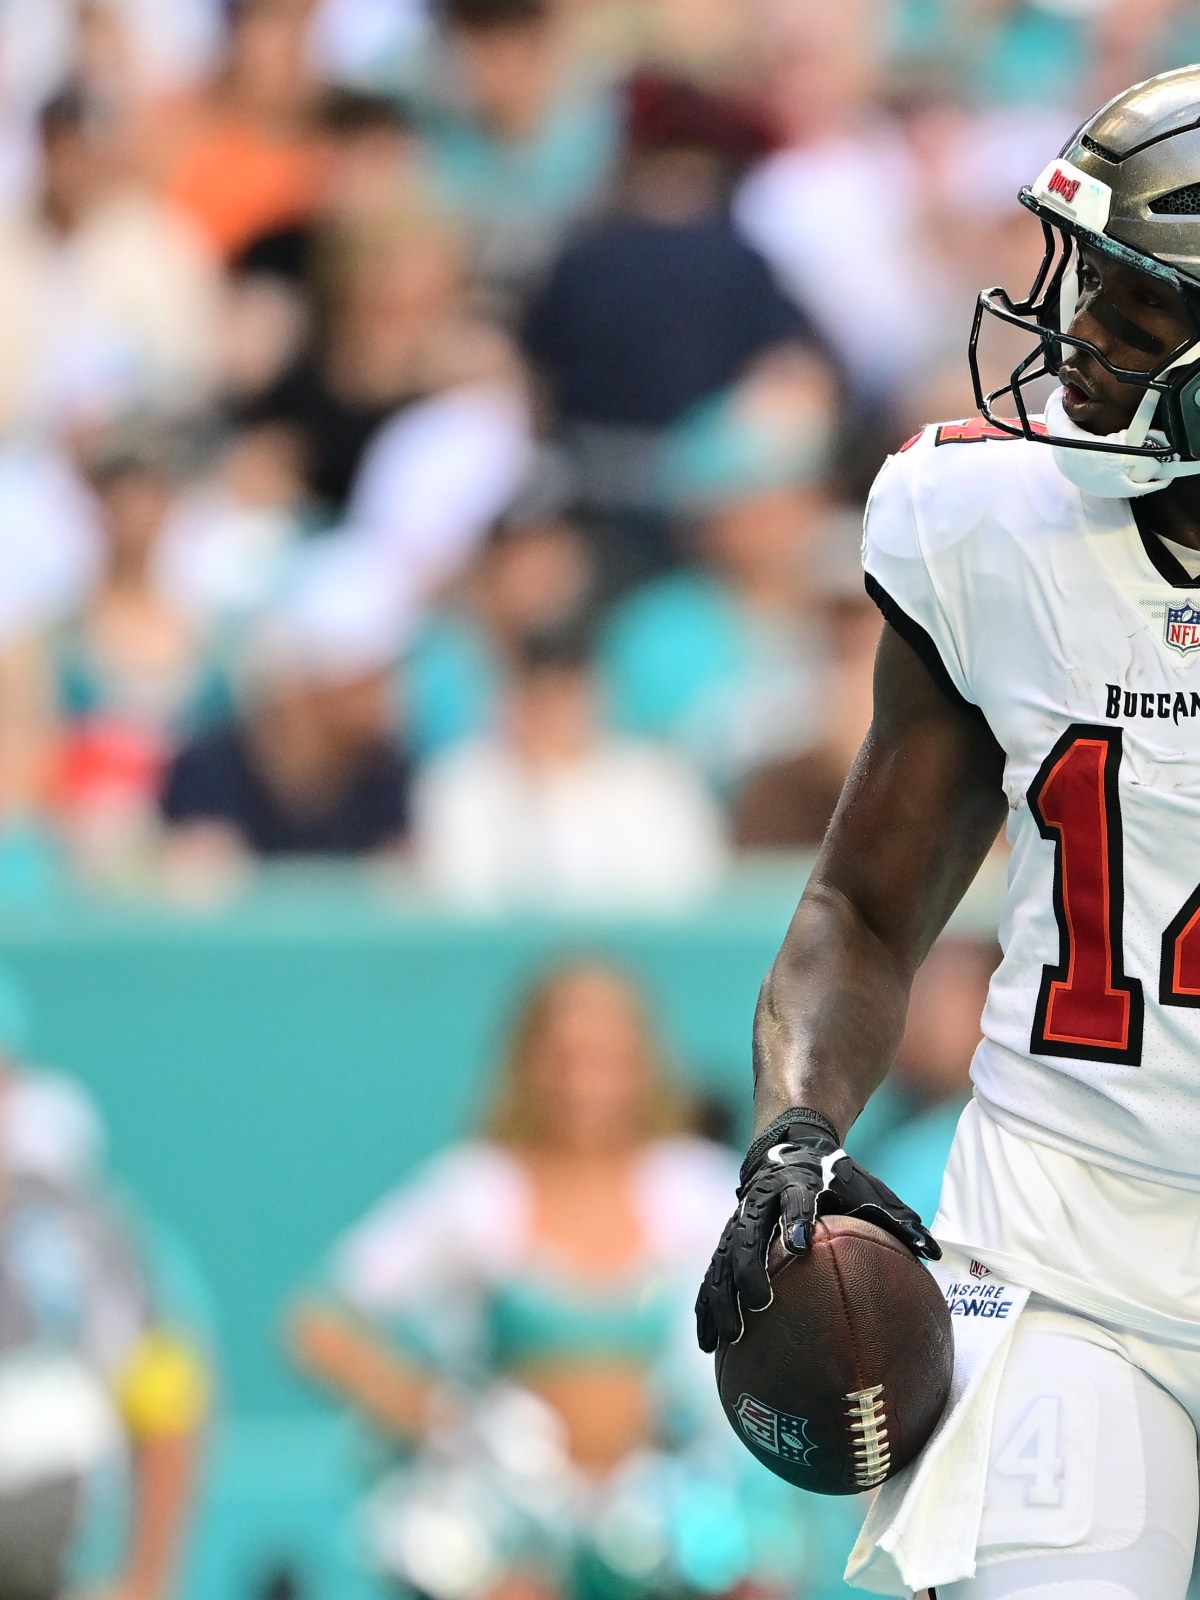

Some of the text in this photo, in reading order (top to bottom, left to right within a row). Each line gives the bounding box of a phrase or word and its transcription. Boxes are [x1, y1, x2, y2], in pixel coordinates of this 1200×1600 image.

[1169, 624, 1200, 646] NFL
[946, 1283, 1005, 1299] INSPIRE
[740, 1400, 777, 1449] NFL
